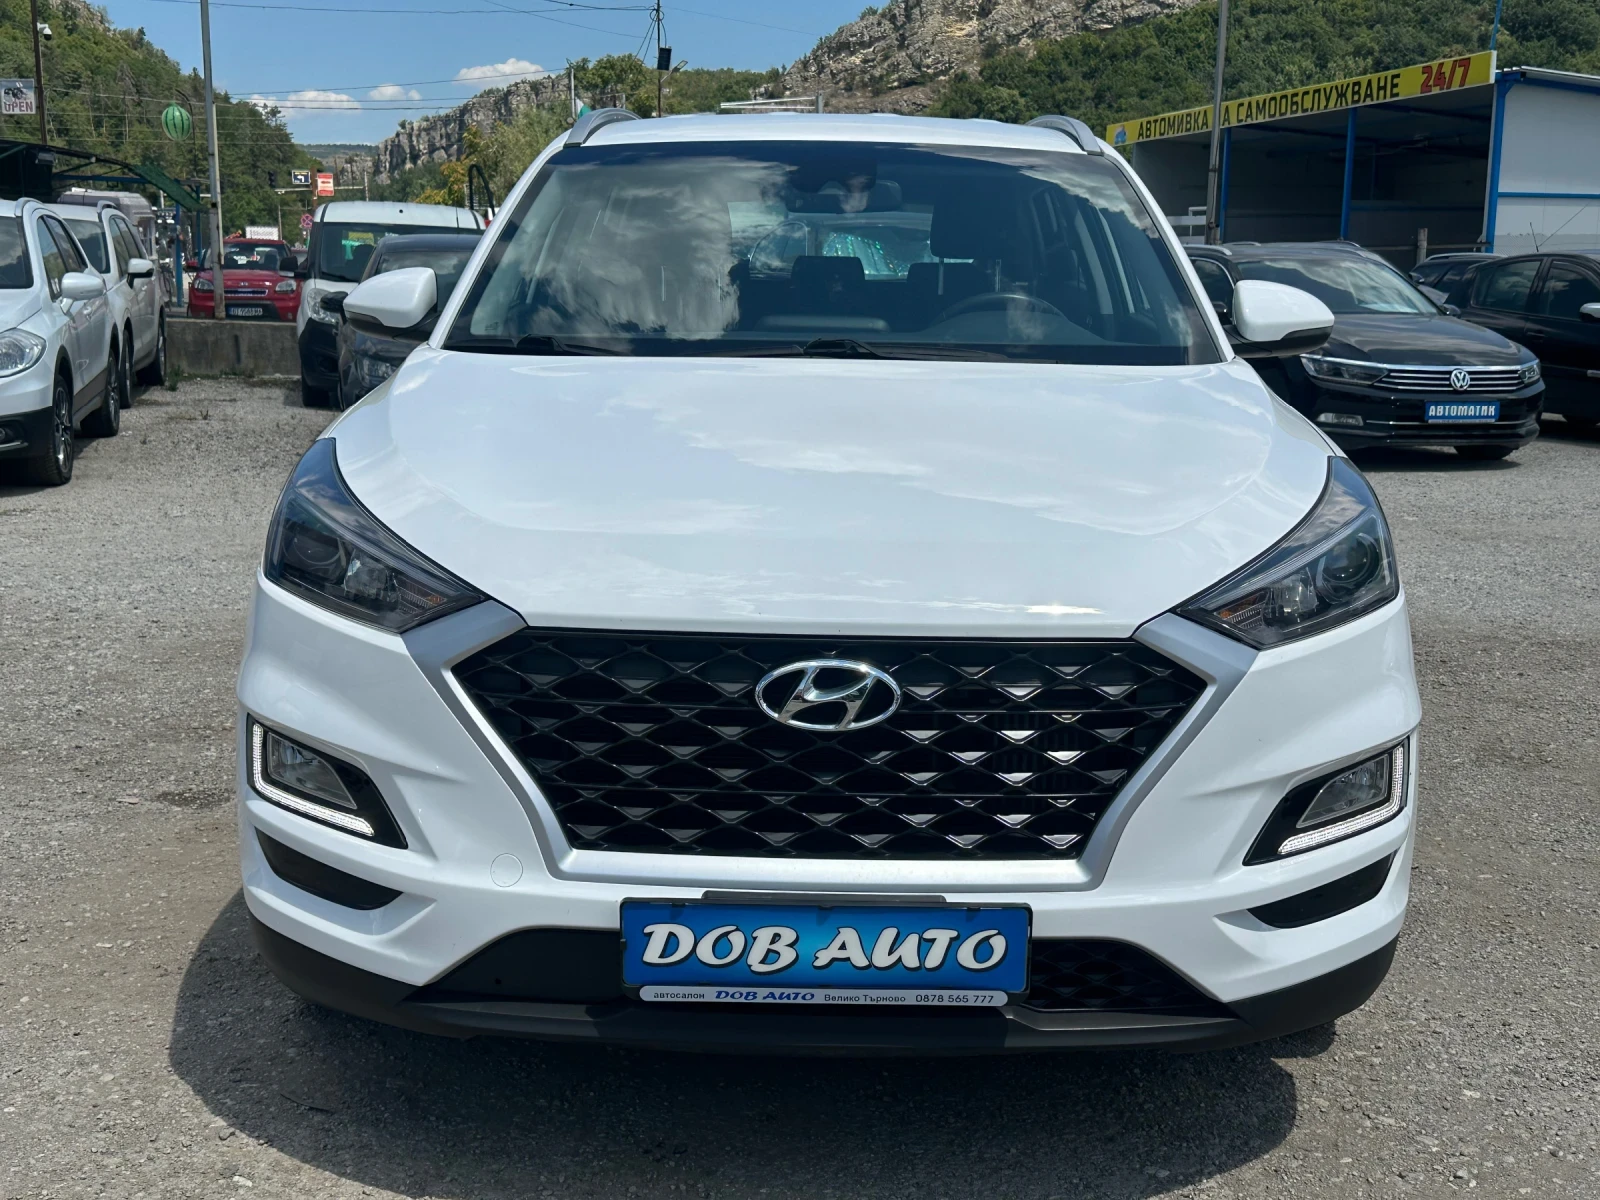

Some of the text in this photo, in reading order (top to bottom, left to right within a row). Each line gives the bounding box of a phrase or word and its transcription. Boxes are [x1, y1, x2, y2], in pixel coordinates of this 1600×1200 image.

[1138, 110, 1208, 140] АВТОМИВКА
[1236, 74, 1400, 124] САМООБСЛУЖВАНЕ
[1420, 57, 1472, 95] 24/7
[4, 101, 33, 112] OPEN
[1428, 405, 1496, 417] АВТОМАТИК
[641, 922, 1008, 976] DOB AUTO
[653, 990, 994, 1005] автосалон DOB AUTO Велико Търново 0878 565 777
